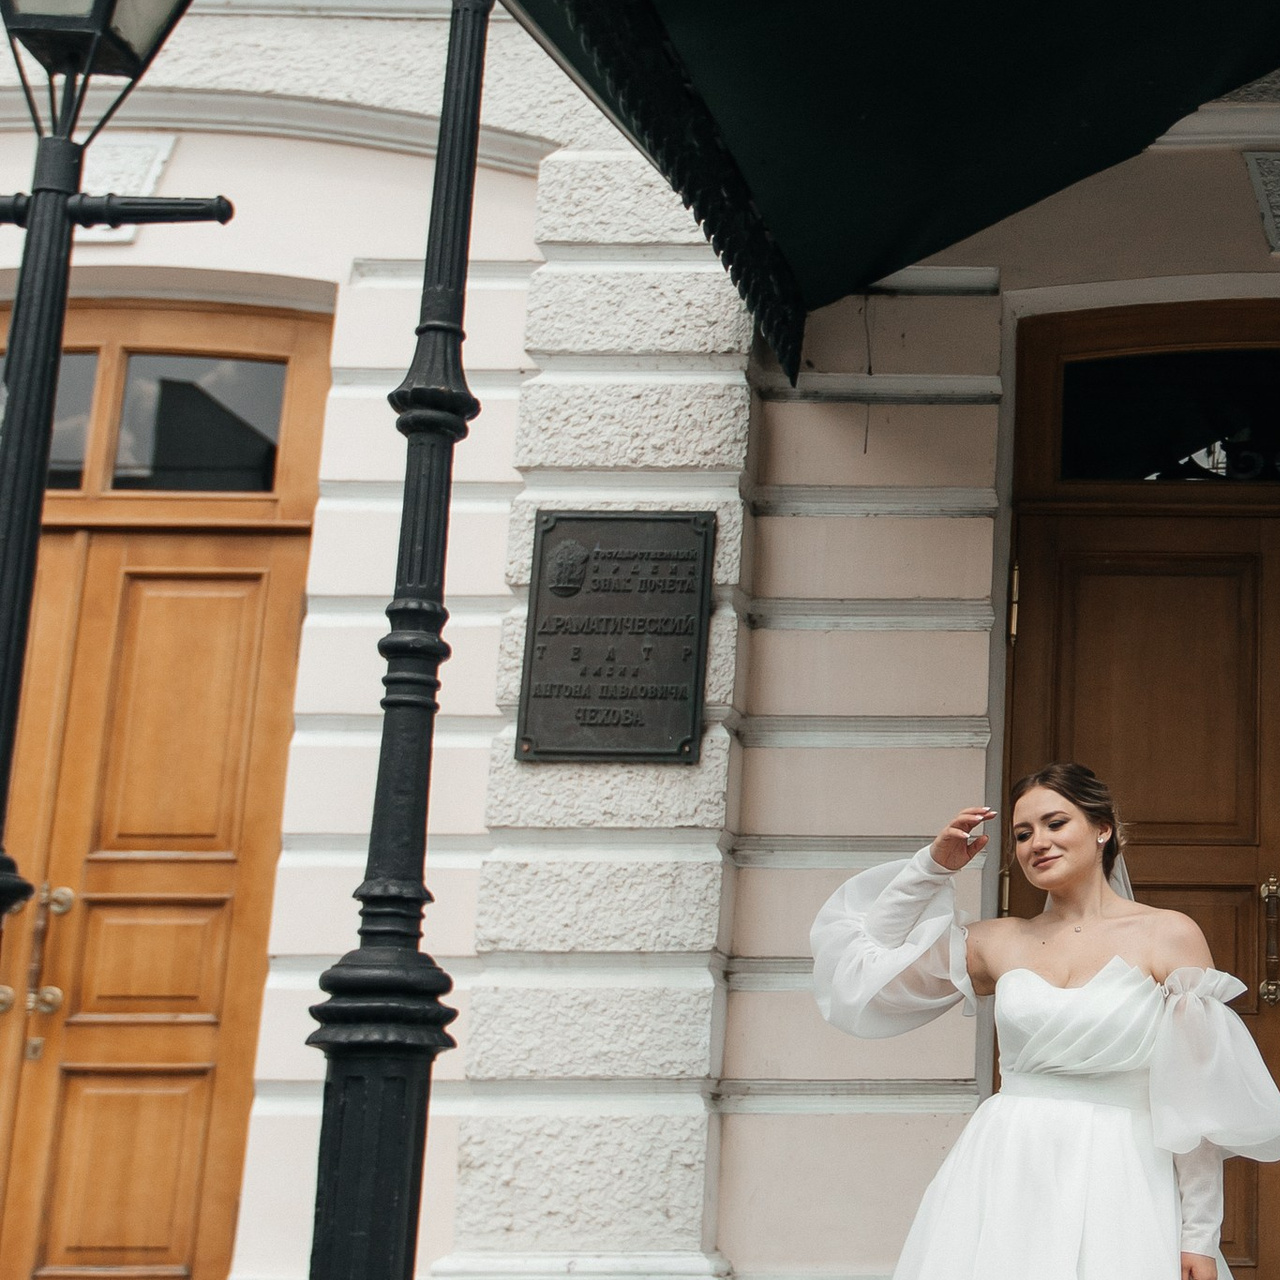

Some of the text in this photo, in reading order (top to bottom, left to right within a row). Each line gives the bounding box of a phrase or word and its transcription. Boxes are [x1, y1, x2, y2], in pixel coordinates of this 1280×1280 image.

[594, 549, 697, 561] ГОСУДАРСТВЕННЫЙ
[593, 563, 695, 575] ОРДЕНА
[591, 577, 696, 593] ЗНАК ПОЧЕТА
[538, 614, 695, 636] ДРАМАТИЧЕСКИЙ
[537, 643, 692, 661] ТЕАТР
[579, 665, 639, 677] ИМЕНИ
[533, 683, 688, 700] АНТОНА ПАВЛОВИЧА
[575, 707, 644, 727] ЧЕХОВА
